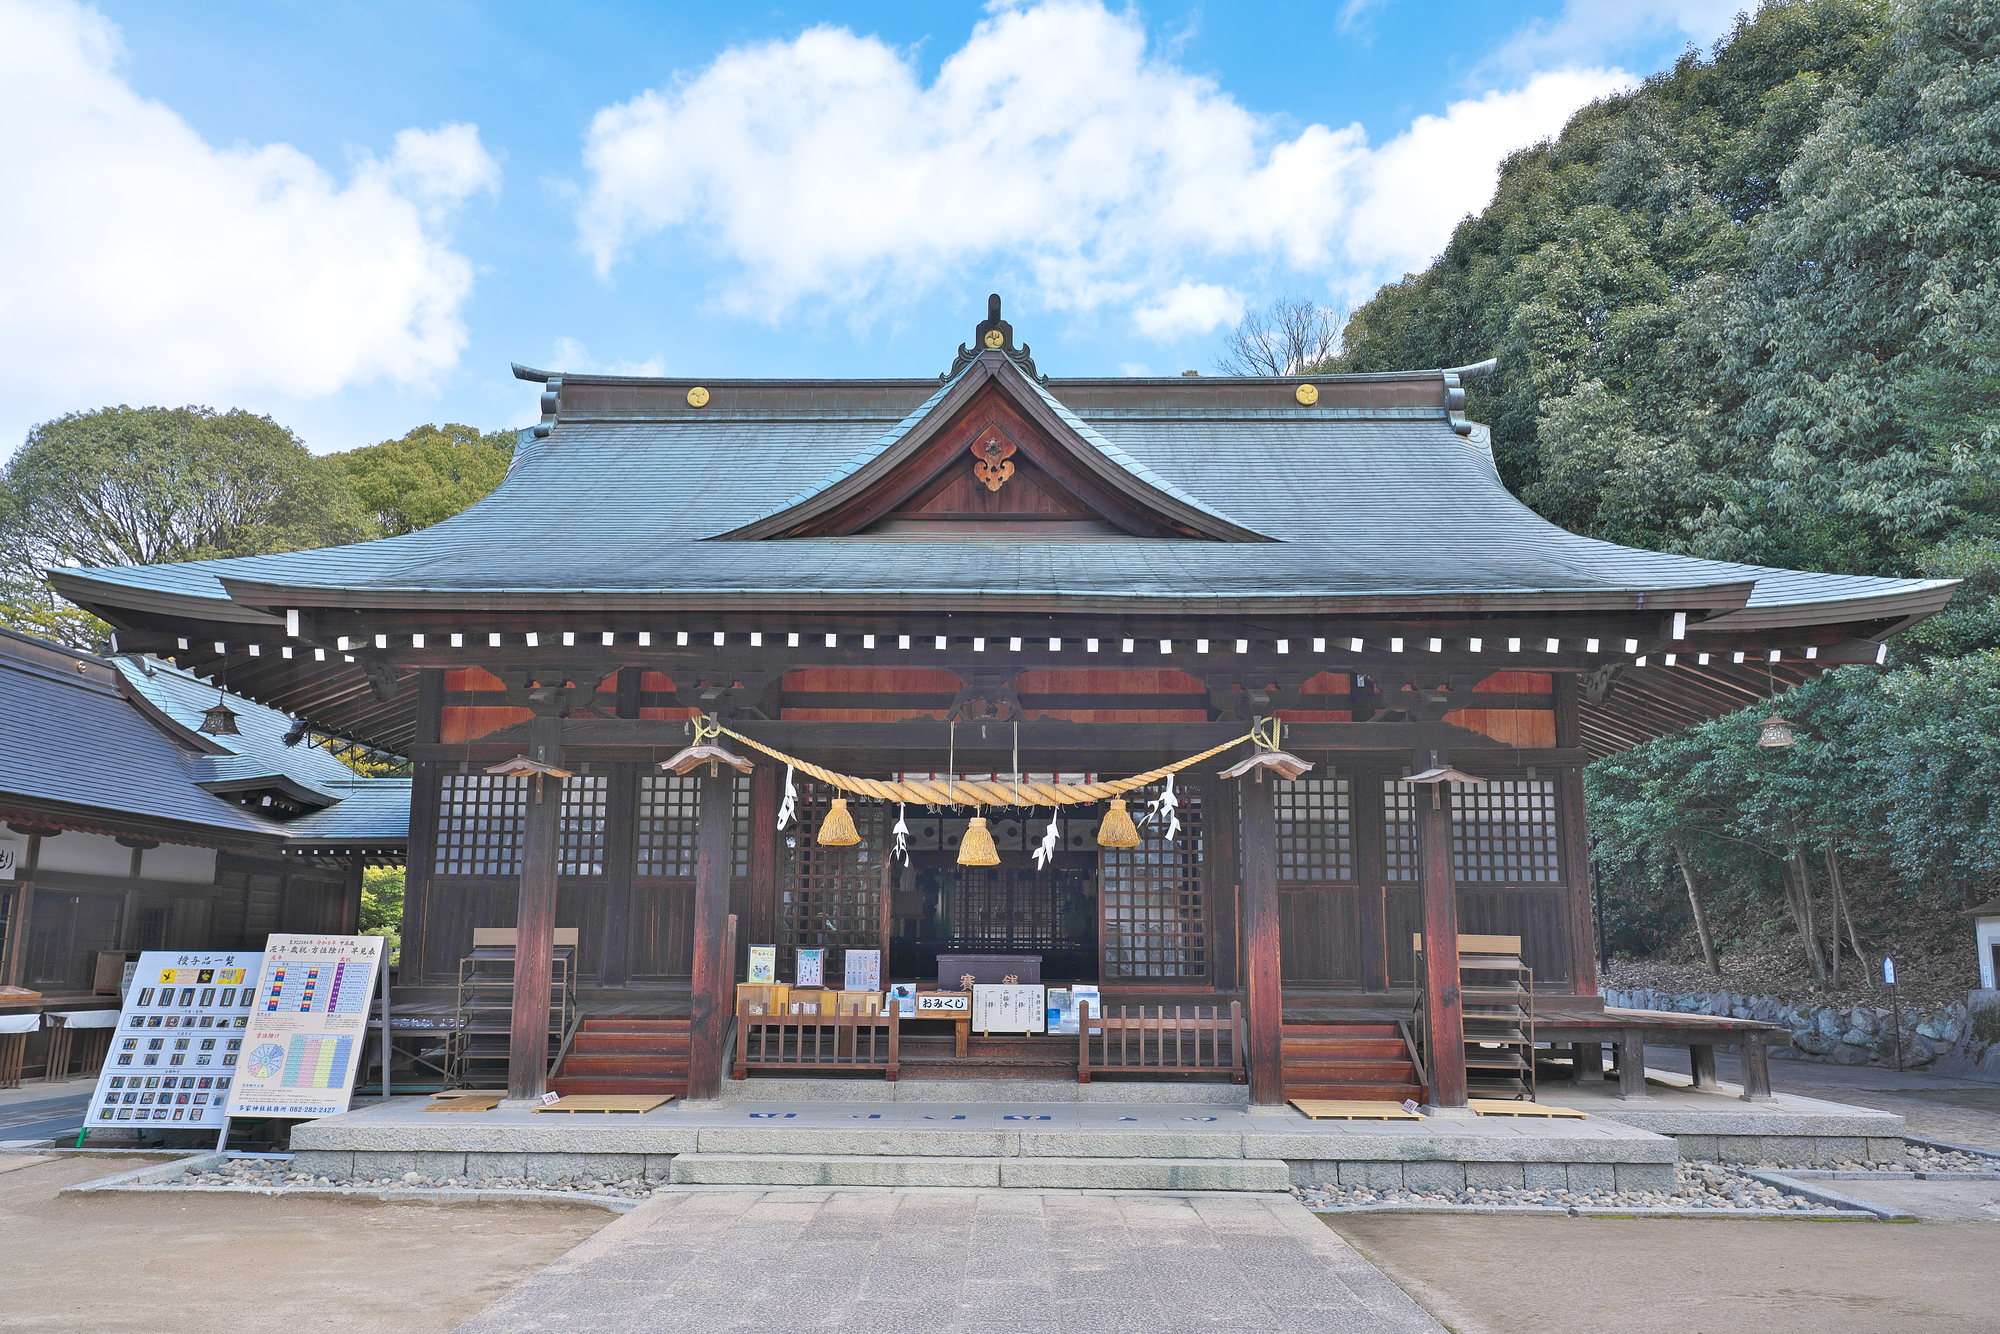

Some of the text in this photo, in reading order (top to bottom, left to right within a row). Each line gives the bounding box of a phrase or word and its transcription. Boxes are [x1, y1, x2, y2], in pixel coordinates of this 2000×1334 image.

[177, 955, 236, 967] 授与品一覧
[922, 997, 965, 1009] おみくじ
